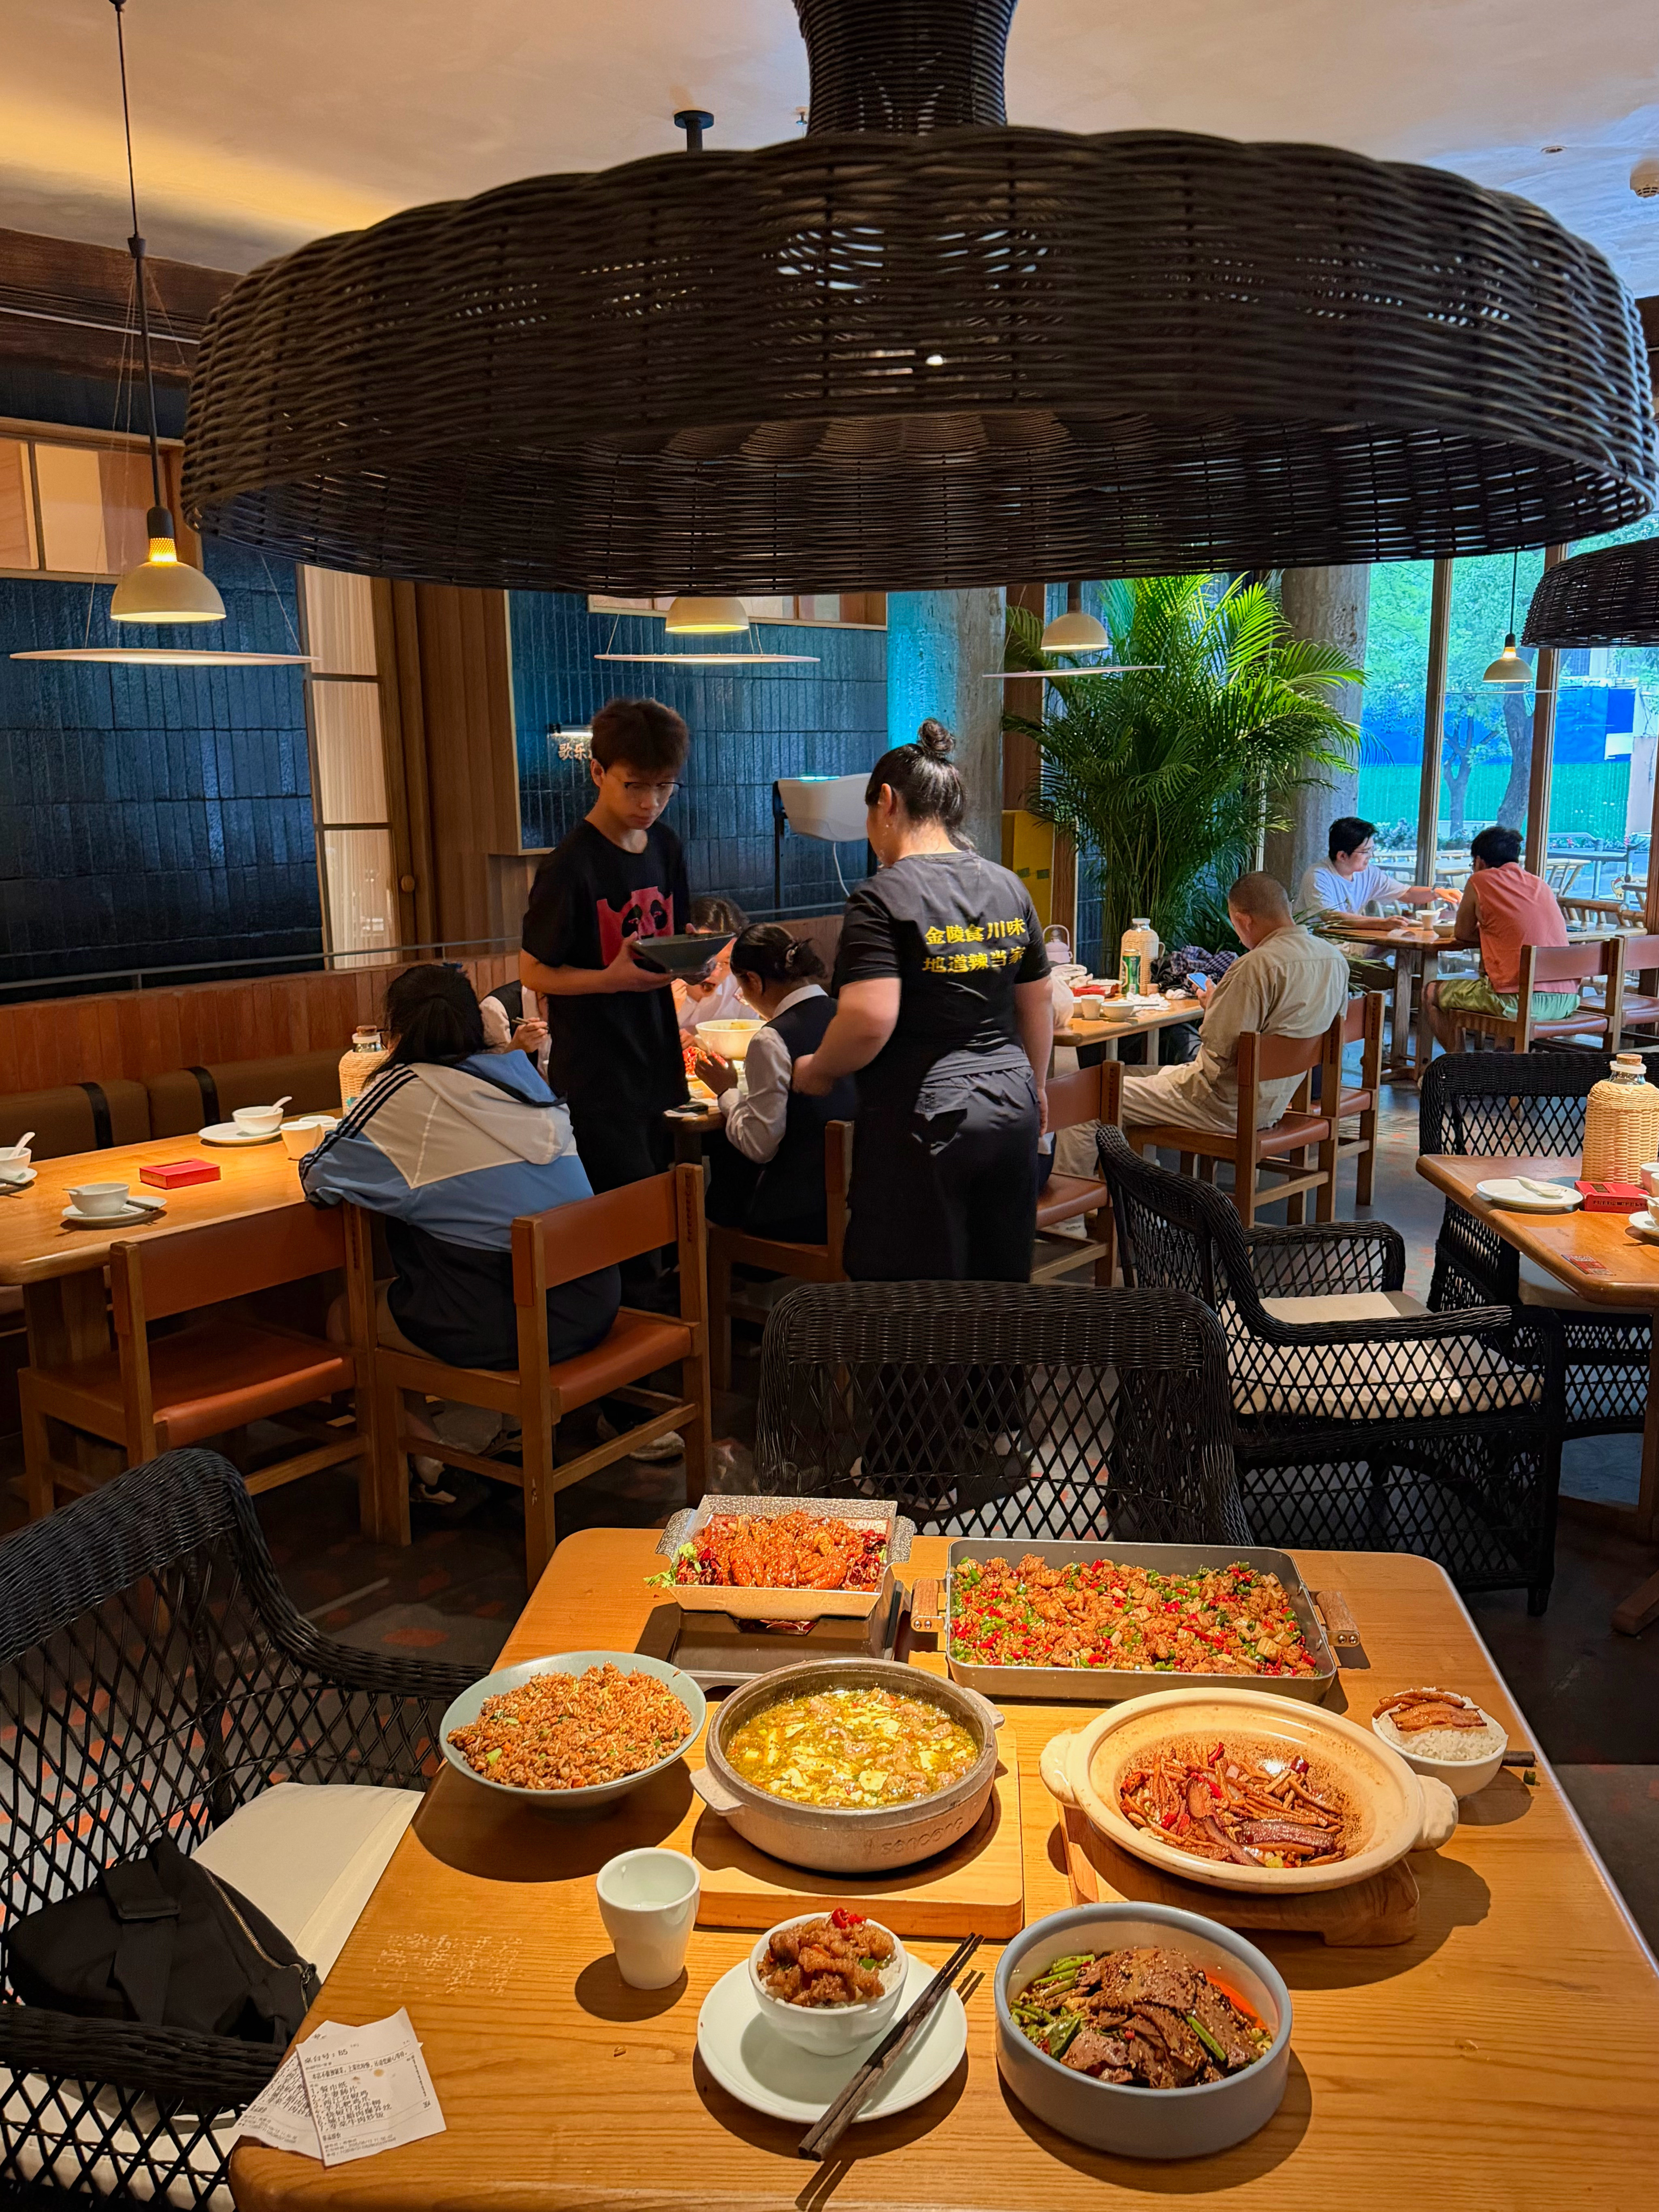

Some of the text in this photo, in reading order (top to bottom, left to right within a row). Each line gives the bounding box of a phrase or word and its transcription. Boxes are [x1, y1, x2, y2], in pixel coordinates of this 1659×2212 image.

[558, 742, 593, 761] 歌乐
[925, 917, 1026, 945] 金陵食川味
[922, 946, 1026, 973] 地道辣当家
